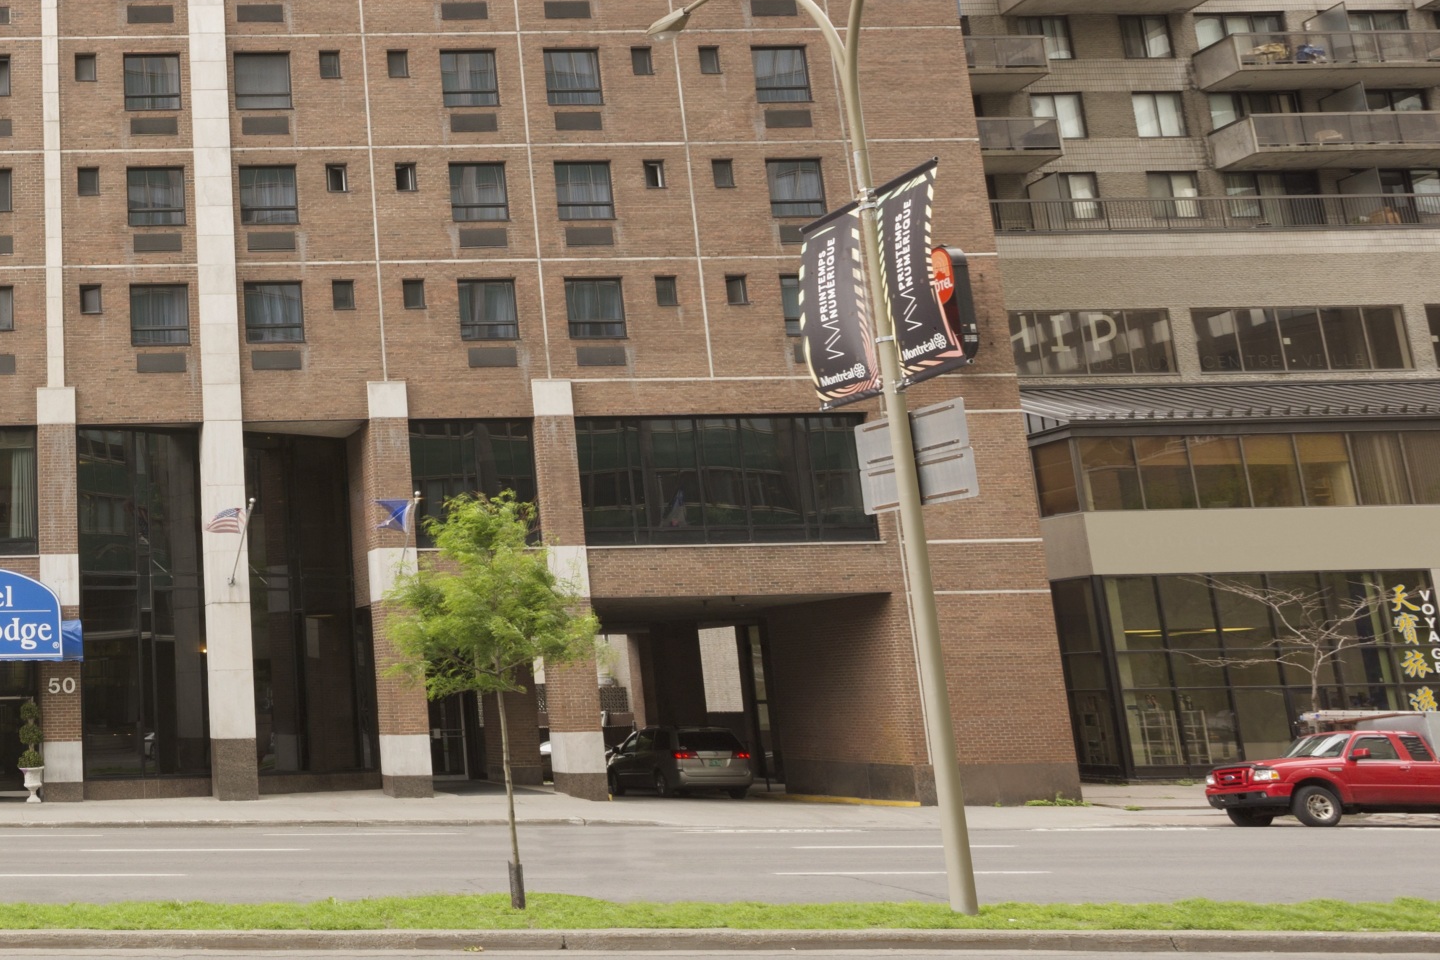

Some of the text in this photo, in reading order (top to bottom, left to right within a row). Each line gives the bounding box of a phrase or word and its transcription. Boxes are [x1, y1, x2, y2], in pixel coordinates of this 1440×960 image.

[826, 237, 839, 319] NUMÉRIQUE
[895, 213, 906, 291] PRINTEMPS
[902, 199, 914, 287] NUMÉRIQUE
[818, 250, 829, 322] PRINTEMPS
[819, 367, 855, 387] Montréal
[902, 338, 937, 362] Montréal
[48, 677, 76, 694] 50
